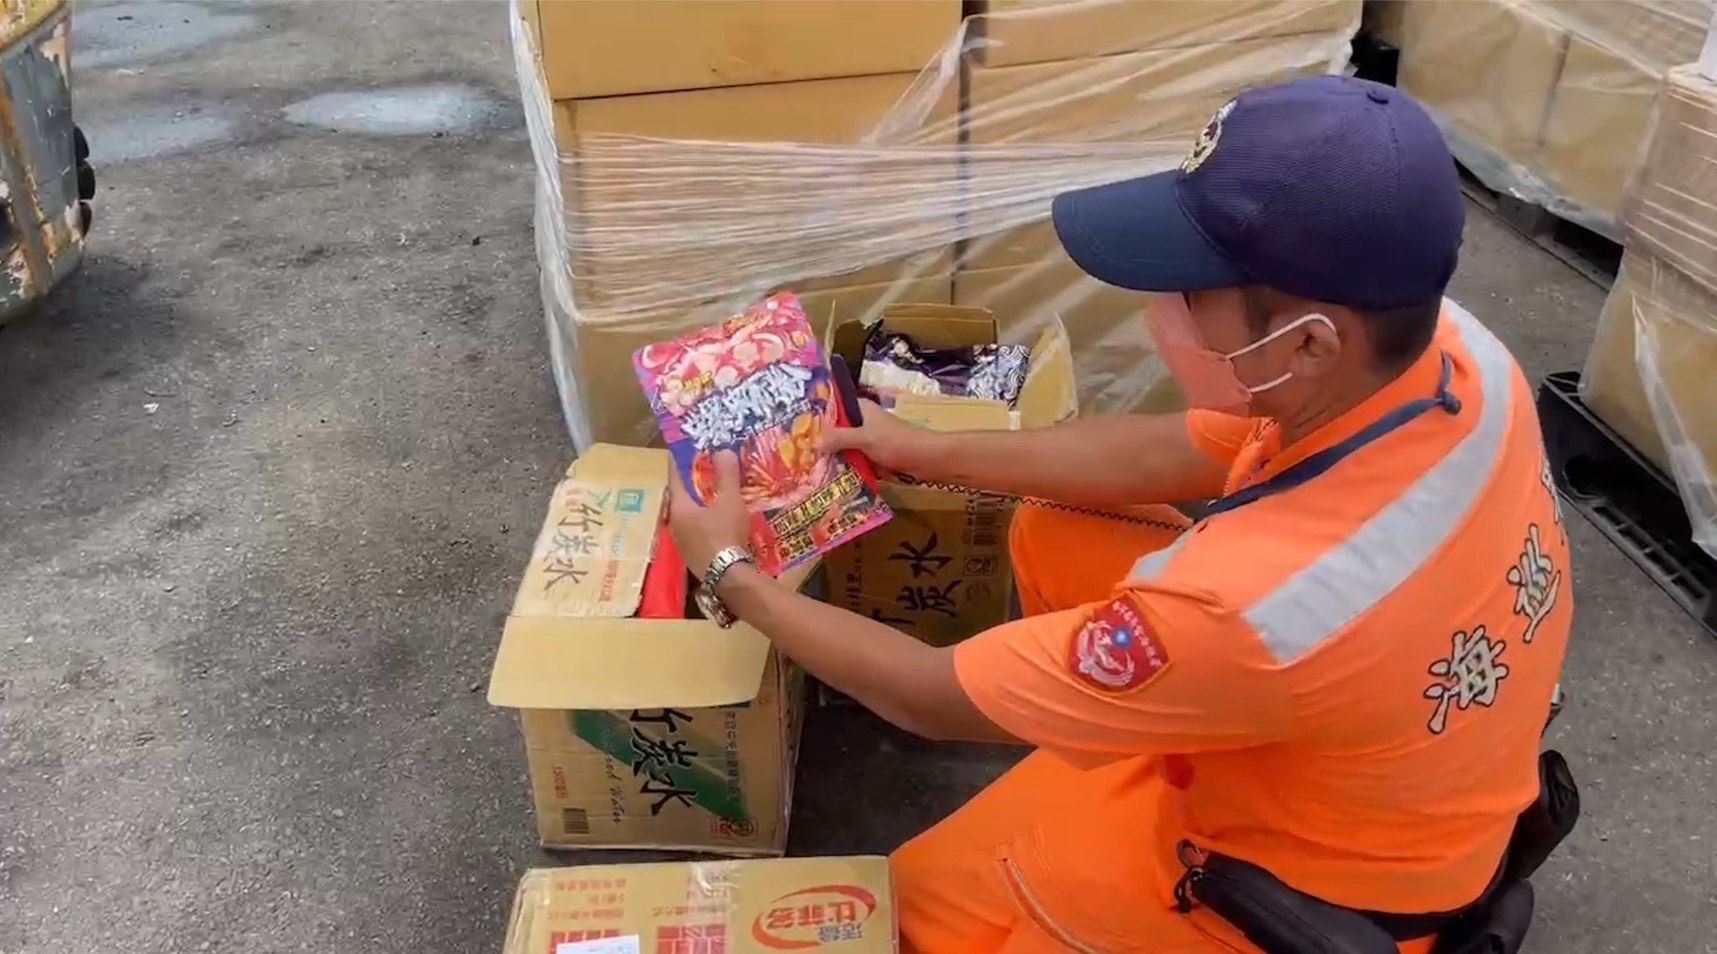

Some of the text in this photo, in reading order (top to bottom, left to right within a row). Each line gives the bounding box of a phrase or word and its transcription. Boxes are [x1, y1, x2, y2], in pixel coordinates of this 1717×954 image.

[543, 502, 604, 590] 竹炭水
[1423, 455, 1566, 735] 海巡
